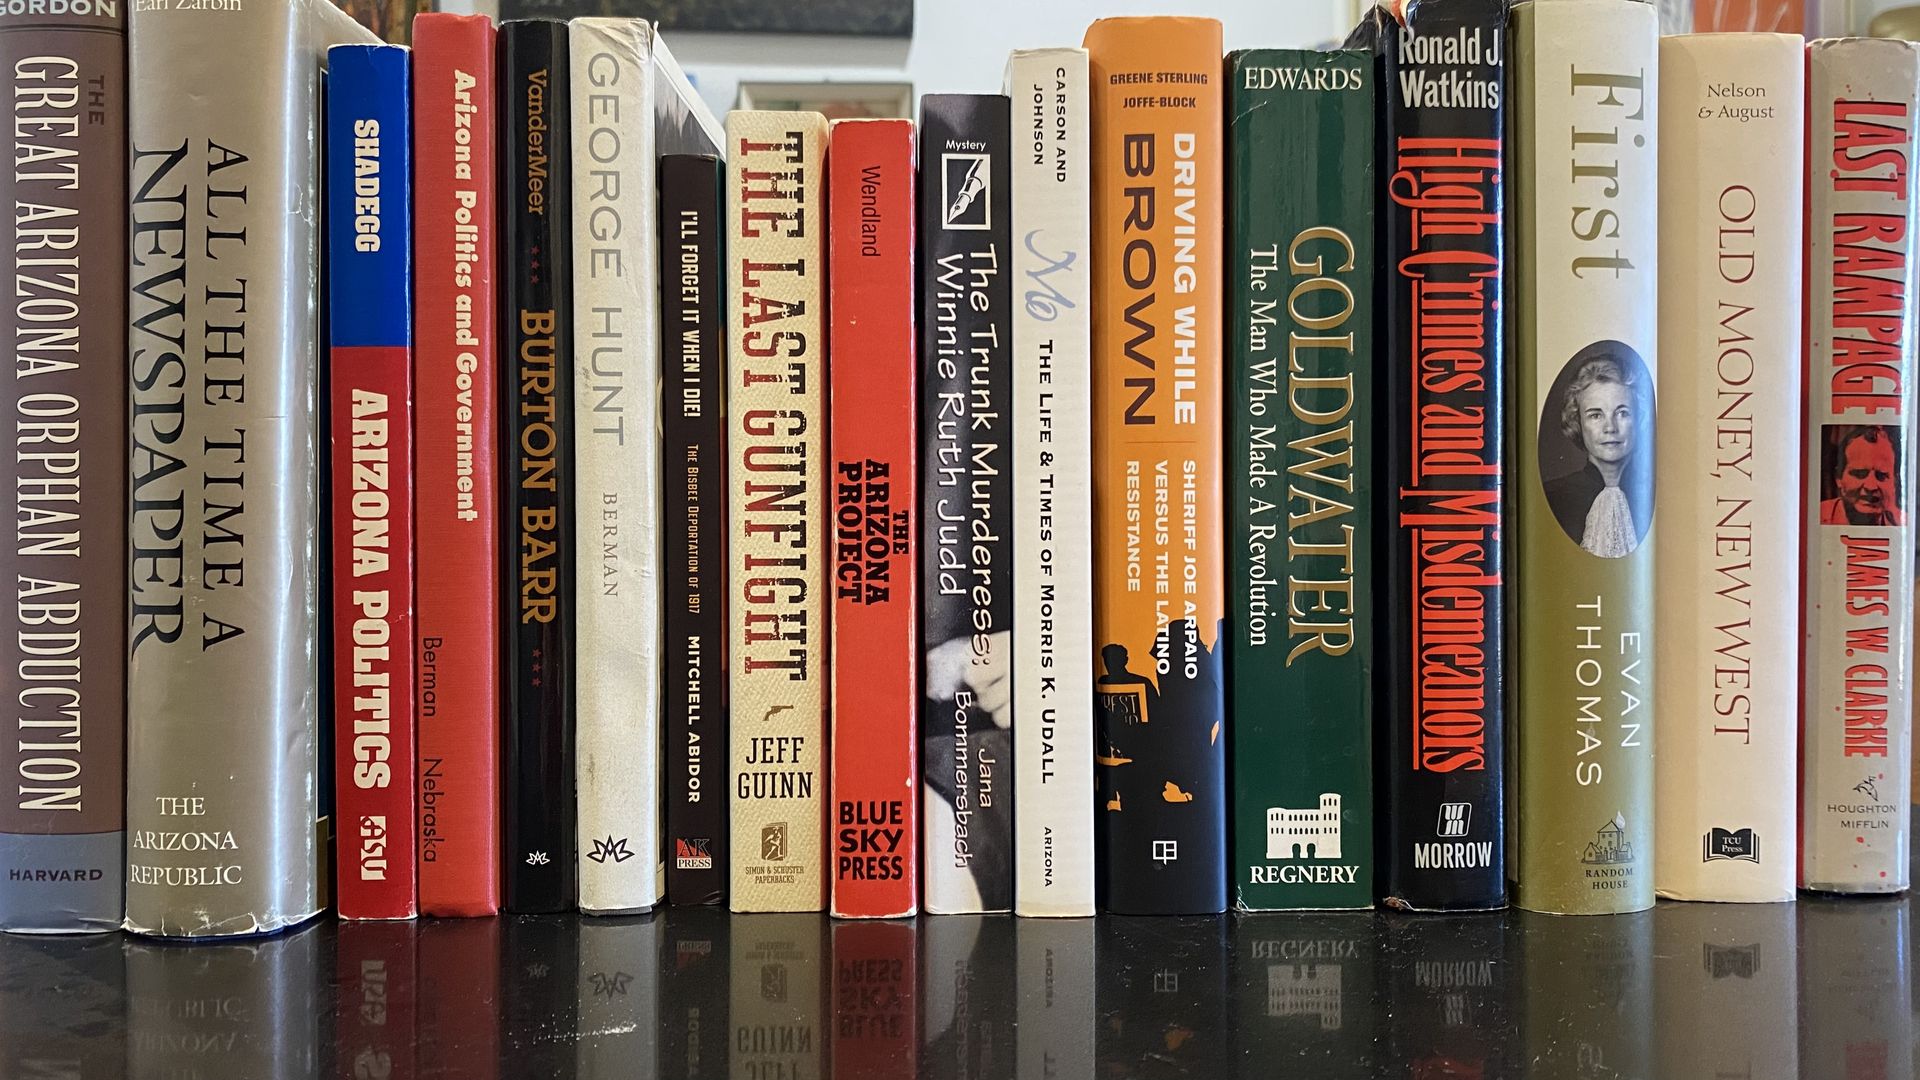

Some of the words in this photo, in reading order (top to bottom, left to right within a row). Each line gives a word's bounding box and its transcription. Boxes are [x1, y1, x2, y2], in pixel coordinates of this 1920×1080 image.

[1110, 73, 1154, 85] GREENE
[1156, 72, 1208, 85] STERLING
[1243, 67, 1362, 91] EDWARDS
[1399, 27, 1480, 65] Ronald
[1486, 28, 1502, 67] J.
[14, 55, 80, 191] GREAT
[88, 75, 105, 126] THE
[453, 69, 477, 180] Arizona
[1033, 84, 1044, 165] JOHNSON
[1056, 68, 1065, 140] CARSON
[1122, 97, 1197, 108] JOFFE-BLOCK
[1399, 70, 1499, 109] Watkins
[1698, 106, 1715, 119] &
[1717, 104, 1774, 122] August
[1708, 83, 1766, 99] Nelson
[528, 68, 548, 215] VanderMeer
[587, 53, 622, 279] GEORGE
[946, 139, 986, 152] Mystery
[1057, 146, 1066, 182] AND
[1571, 63, 1646, 280] First
[1830, 98, 1907, 200] LAST
[206, 138, 249, 261] ALL
[353, 119, 381, 253] SHADEGG
[741, 132, 804, 237] THE
[861, 166, 881, 257] Wendland
[1173, 134, 1195, 293] DRIVING
[1389, 136, 1502, 238] High
[454, 190, 479, 287] Politics
[681, 211, 698, 239] I'LL
[1718, 184, 1756, 284] OLD
[15, 200, 80, 381] ARIZONA
[681, 245, 699, 304] FORGET
[970, 243, 998, 312] The
[1024, 229, 1076, 321] Mo
[1122, 134, 1156, 425] BROWN
[1250, 244, 1278, 291] The
[205, 278, 247, 407] THE
[455, 295, 480, 346] and
[682, 309, 700, 323] IT
[682, 330, 700, 373] WHEN
[742, 259, 806, 394] LAST
[936, 253, 965, 379] Winnie
[1250, 299, 1277, 352] Man
[1398, 250, 1502, 393] Crimes
[1831, 213, 1906, 416] RAMPAGE
[591, 307, 624, 446] HUNT
[970, 324, 999, 430] Trunk
[1039, 339, 1053, 384] THE
[1174, 307, 1196, 424] WHILE
[1250, 357, 1277, 417] Who
[1711, 300, 1755, 481] MONEY,
[131, 138, 188, 662] NEWSPAPER
[455, 352, 480, 522] Government
[520, 309, 557, 495] BURTON
[683, 388, 701, 417] DIE!
[1039, 393, 1053, 442] LIFE
[16, 392, 81, 557] ORPHAN
[688, 444, 699, 462] THE
[937, 391, 966, 486] Ruth
[1040, 451, 1053, 467] &
[1250, 425, 1277, 488] Made
[1287, 226, 1355, 668] GOLDWATER
[1421, 403, 1502, 476] and
[203, 428, 247, 590] TIME
[351, 388, 390, 577] ARIZONA
[688, 467, 699, 501] BISBEE
[1040, 474, 1053, 541] TIMES
[1155, 460, 1168, 545] VERSUS
[1183, 460, 1196, 550] SHERIFF
[1250, 497, 1276, 515] A
[603, 492, 618, 597] BERMAN
[688, 506, 700, 573] DEPORTATION
[743, 410, 808, 681] GUNFIGHT
[838, 462, 862, 603] PROJECT
[865, 459, 889, 606] ARIZONA
[893, 510, 909, 555] THE
[936, 499, 967, 595] Judd
[971, 443, 999, 665] Murderess:
[1040, 549, 1053, 577] OF
[1127, 461, 1140, 592] RESISTANCE
[1714, 496, 1752, 609] NEW
[522, 506, 557, 624] BARR
[688, 577, 699, 588] OF
[1156, 552, 1169, 594] THE
[1184, 555, 1197, 594] JOE
[1249, 524, 1277, 646] Revolution
[1842, 534, 1890, 616] JAMES
[202, 612, 246, 653] A
[689, 593, 700, 614] 1917
[1041, 584, 1054, 667] MORRIS
[1156, 601, 1170, 675] LATINO
[1184, 600, 1198, 679] ARPAIO
[1400, 487, 1503, 773] Misdemeanors
[422, 636, 443, 718] Berman
[1844, 627, 1890, 657] W.
[17, 574, 82, 812] ABDUCTION
[352, 590, 391, 790] POLITICS
[687, 636, 700, 726] MITCHELL
[1042, 677, 1055, 699] K.
[1575, 596, 1602, 786] THOMAS
[1620, 632, 1640, 747] EVAN
[1714, 620, 1751, 745] WEST
[1844, 664, 1889, 758] CLARKE
[687, 731, 700, 804] ABIDOR
[746, 737, 805, 764] JEFF
[955, 691, 973, 868] Bommersbach
[978, 749, 996, 808] Jana
[1042, 709, 1055, 784] UDALL
[156, 797, 206, 817] THE
[422, 758, 443, 863] Nebraska
[737, 771, 813, 799] GUINN
[838, 801, 903, 825] BLUE
[1827, 804, 1896, 813] HOUGHTON
[133, 832, 239, 852] ARIZONA
[677, 838, 711, 857] AK
[839, 829, 904, 853] SKY
[1044, 827, 1053, 887] ARIZONA
[1415, 842, 1492, 869] MORROW
[1840, 820, 1889, 828] MIFFLIN
[9, 868, 103, 883] HARVARD
[130, 865, 243, 886] REPUBLIC
[678, 859, 711, 868] PRESS
[745, 866, 765, 875] SIMON
[766, 866, 772, 874] &
[773, 865, 804, 874] SCHUSTER
[754, 876, 795, 884] PAPERBACKS
[838, 856, 903, 880] PRESS
[1250, 866, 1358, 884] REGNERY
[1585, 867, 1633, 878] RANDOM
[1592, 880, 1629, 889] HOUSE
